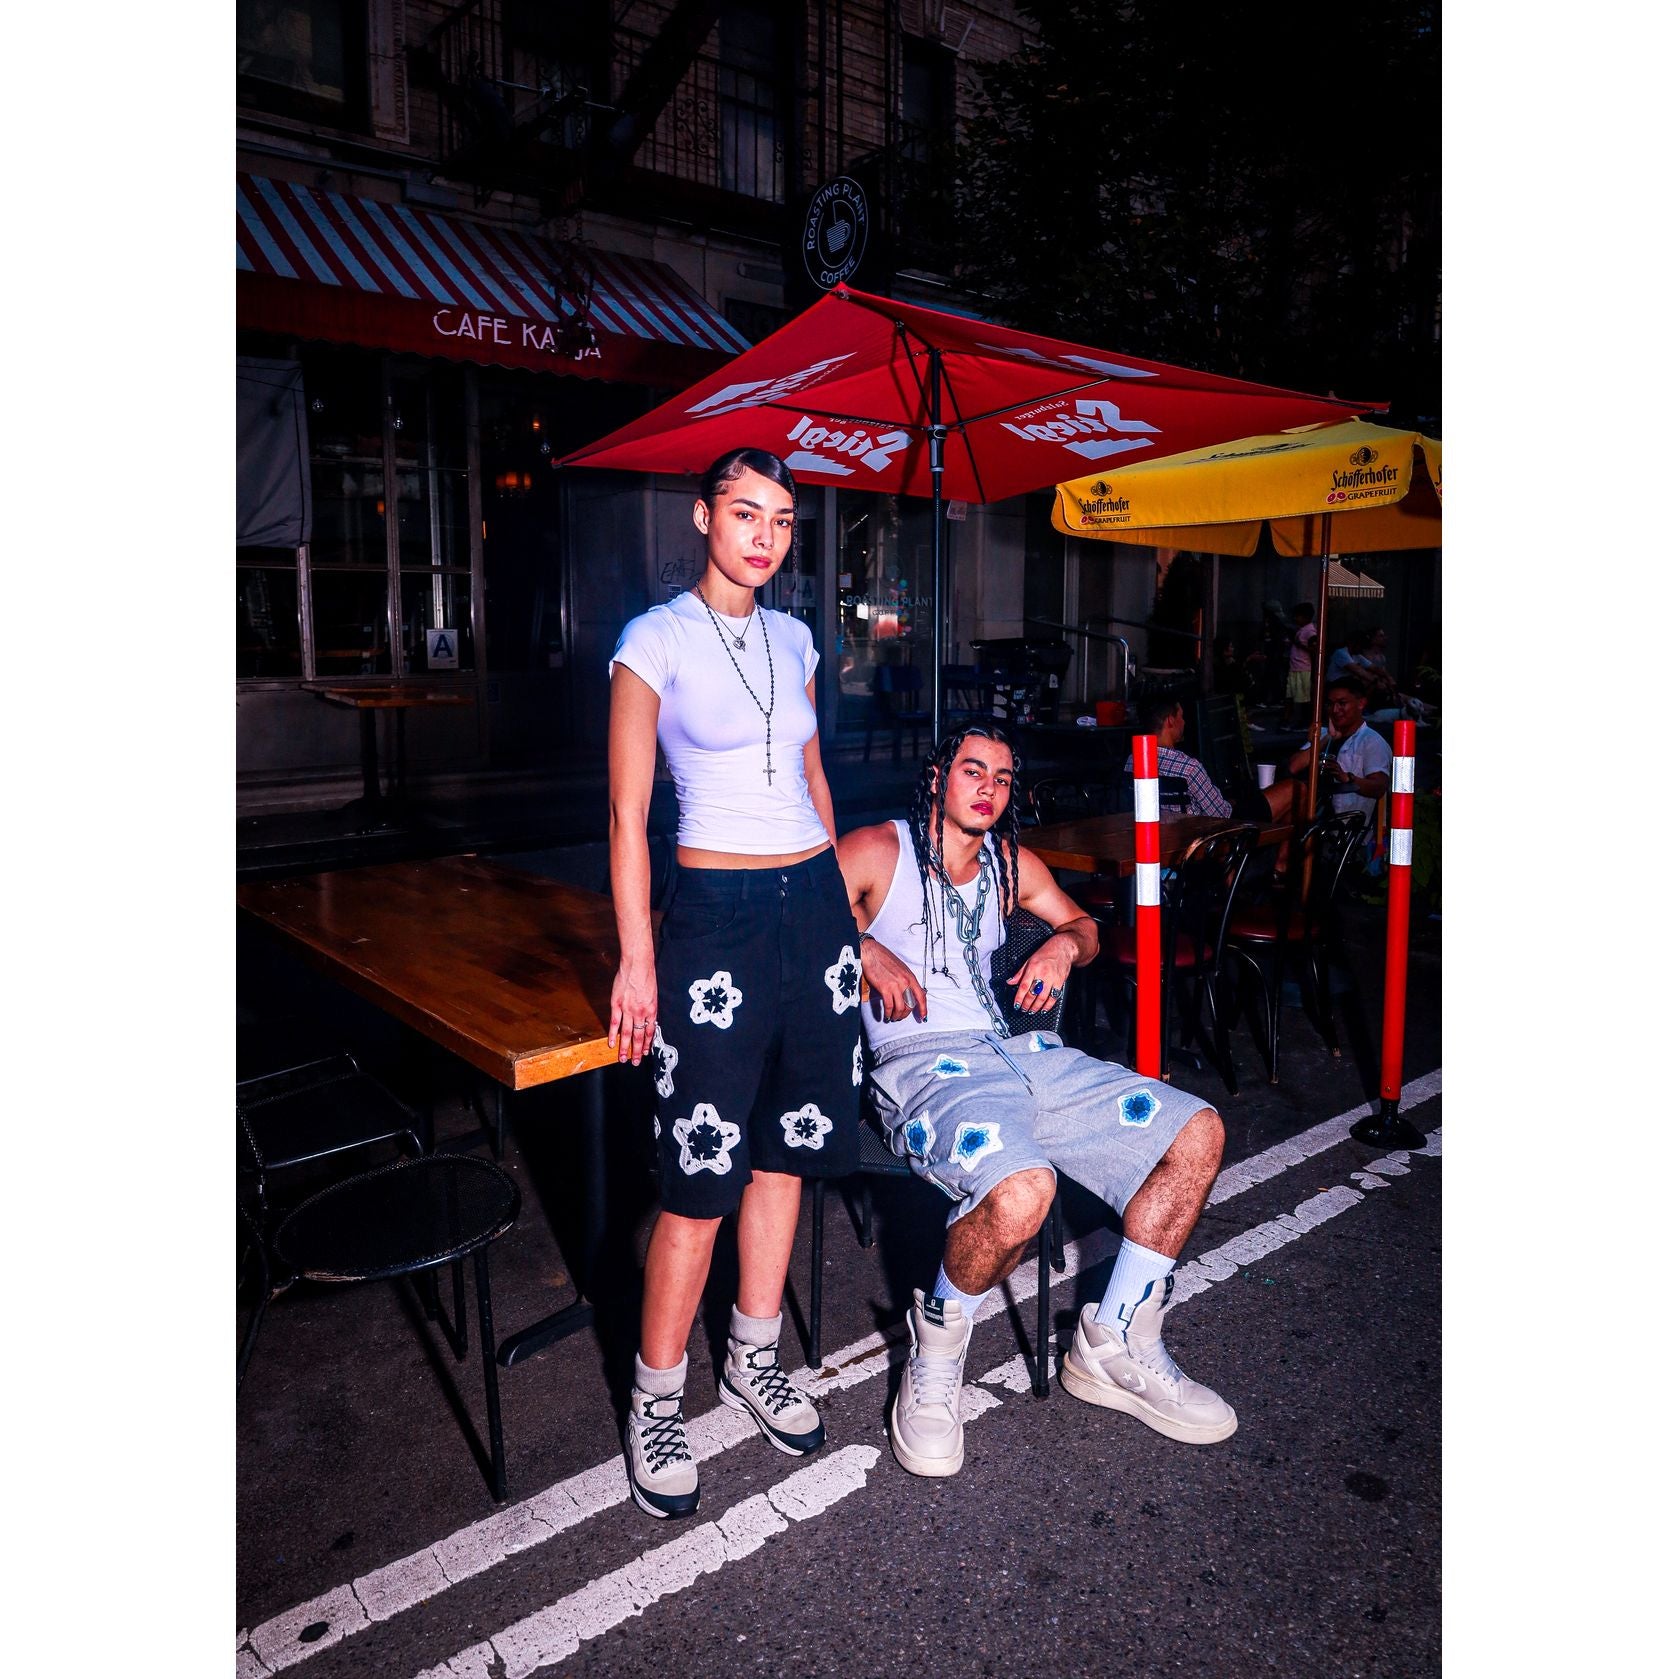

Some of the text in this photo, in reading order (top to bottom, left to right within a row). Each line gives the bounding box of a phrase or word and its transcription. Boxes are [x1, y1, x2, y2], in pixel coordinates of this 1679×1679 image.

[807, 184, 865, 249] ROASTING PLANT
[820, 256, 855, 283] COFFEE
[433, 309, 512, 345] CAFE
[1331, 464, 1398, 491] Schöfferhofer
[1347, 487, 1397, 501] GRAPEFRUIT
[432, 634, 453, 658] A
